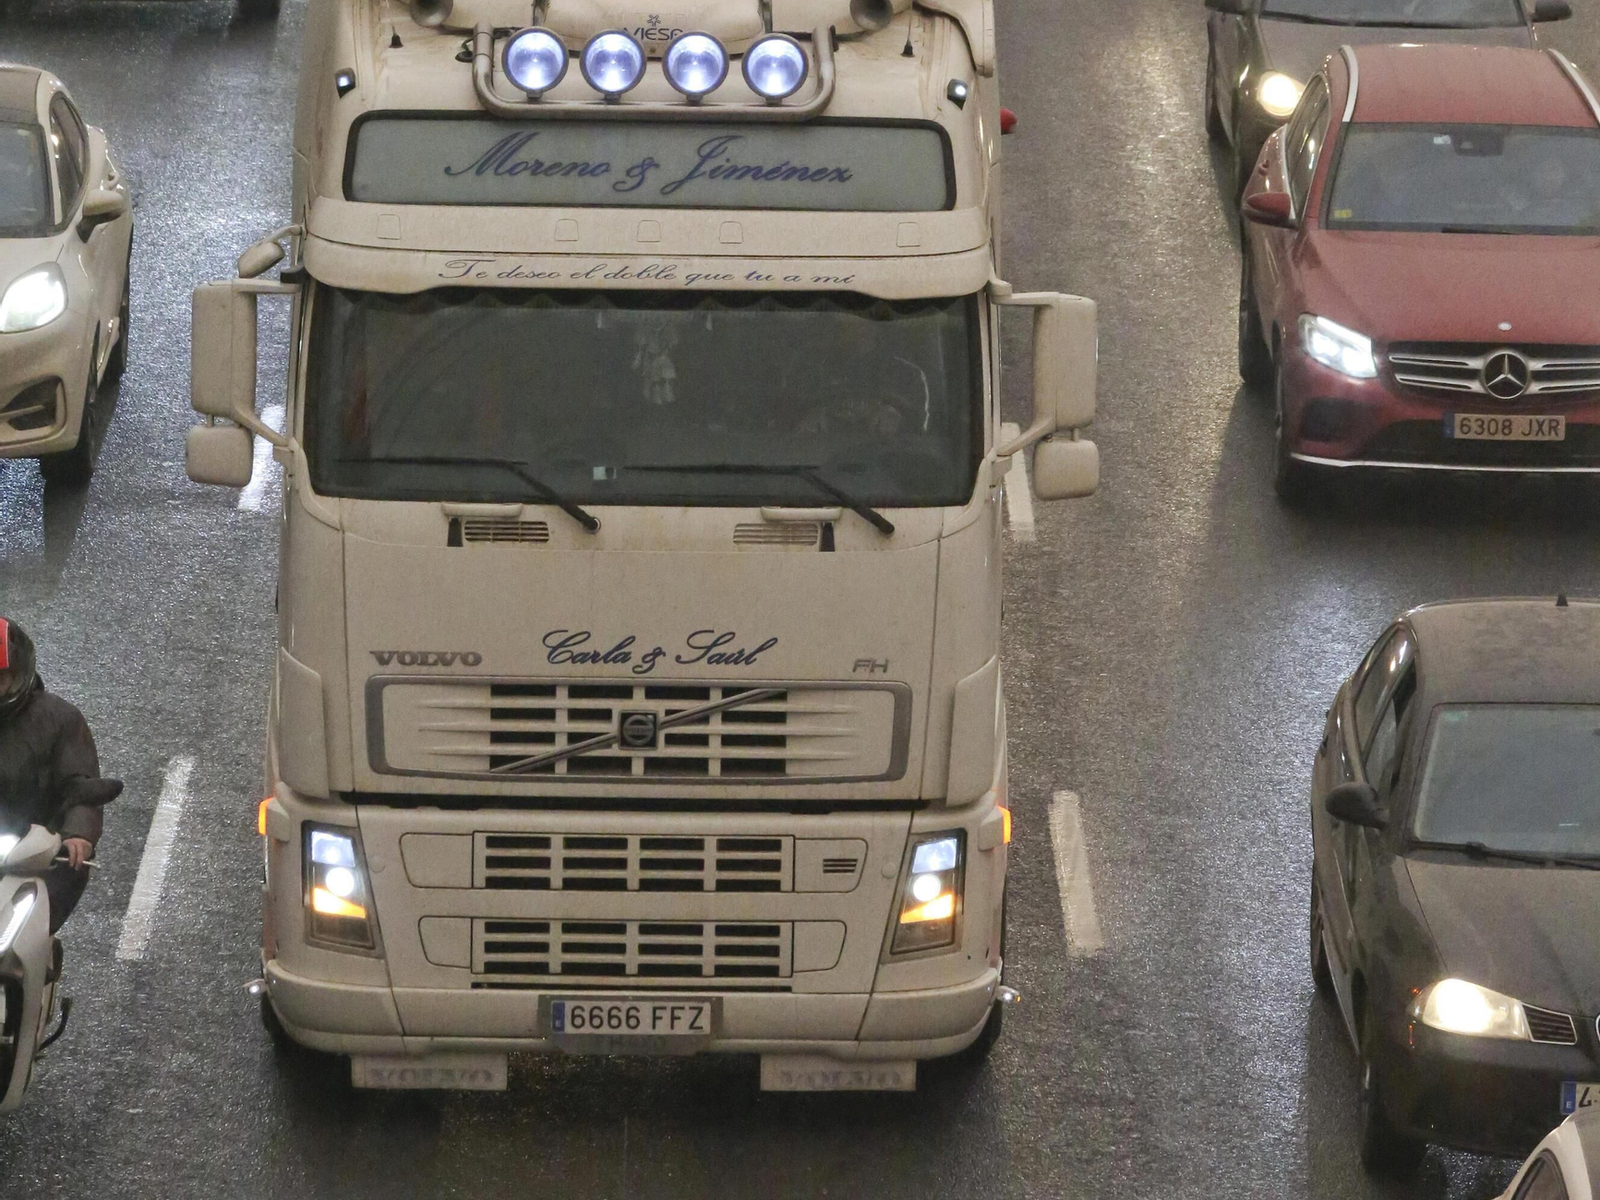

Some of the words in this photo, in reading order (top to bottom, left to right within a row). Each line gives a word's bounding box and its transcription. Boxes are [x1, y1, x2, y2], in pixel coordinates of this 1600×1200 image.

[444, 130, 612, 177] Moreno
[612, 156, 661, 193] &
[438, 259, 496, 279] Te
[497, 265, 562, 279] deseo
[569, 263, 607, 280] el
[603, 264, 678, 280] doble
[684, 271, 735, 287] que
[743, 270, 775, 282] tu
[783, 274, 802, 283] a
[1460, 417, 1513, 436] 6308
[1521, 418, 1560, 437] JXR
[369, 650, 483, 667] VOLVO
[542, 629, 637, 665] Carla
[632, 646, 666, 675] &
[852, 658, 890, 673] FH
[570, 1005, 641, 1030] 6666
[652, 1006, 704, 1030] FFZ
